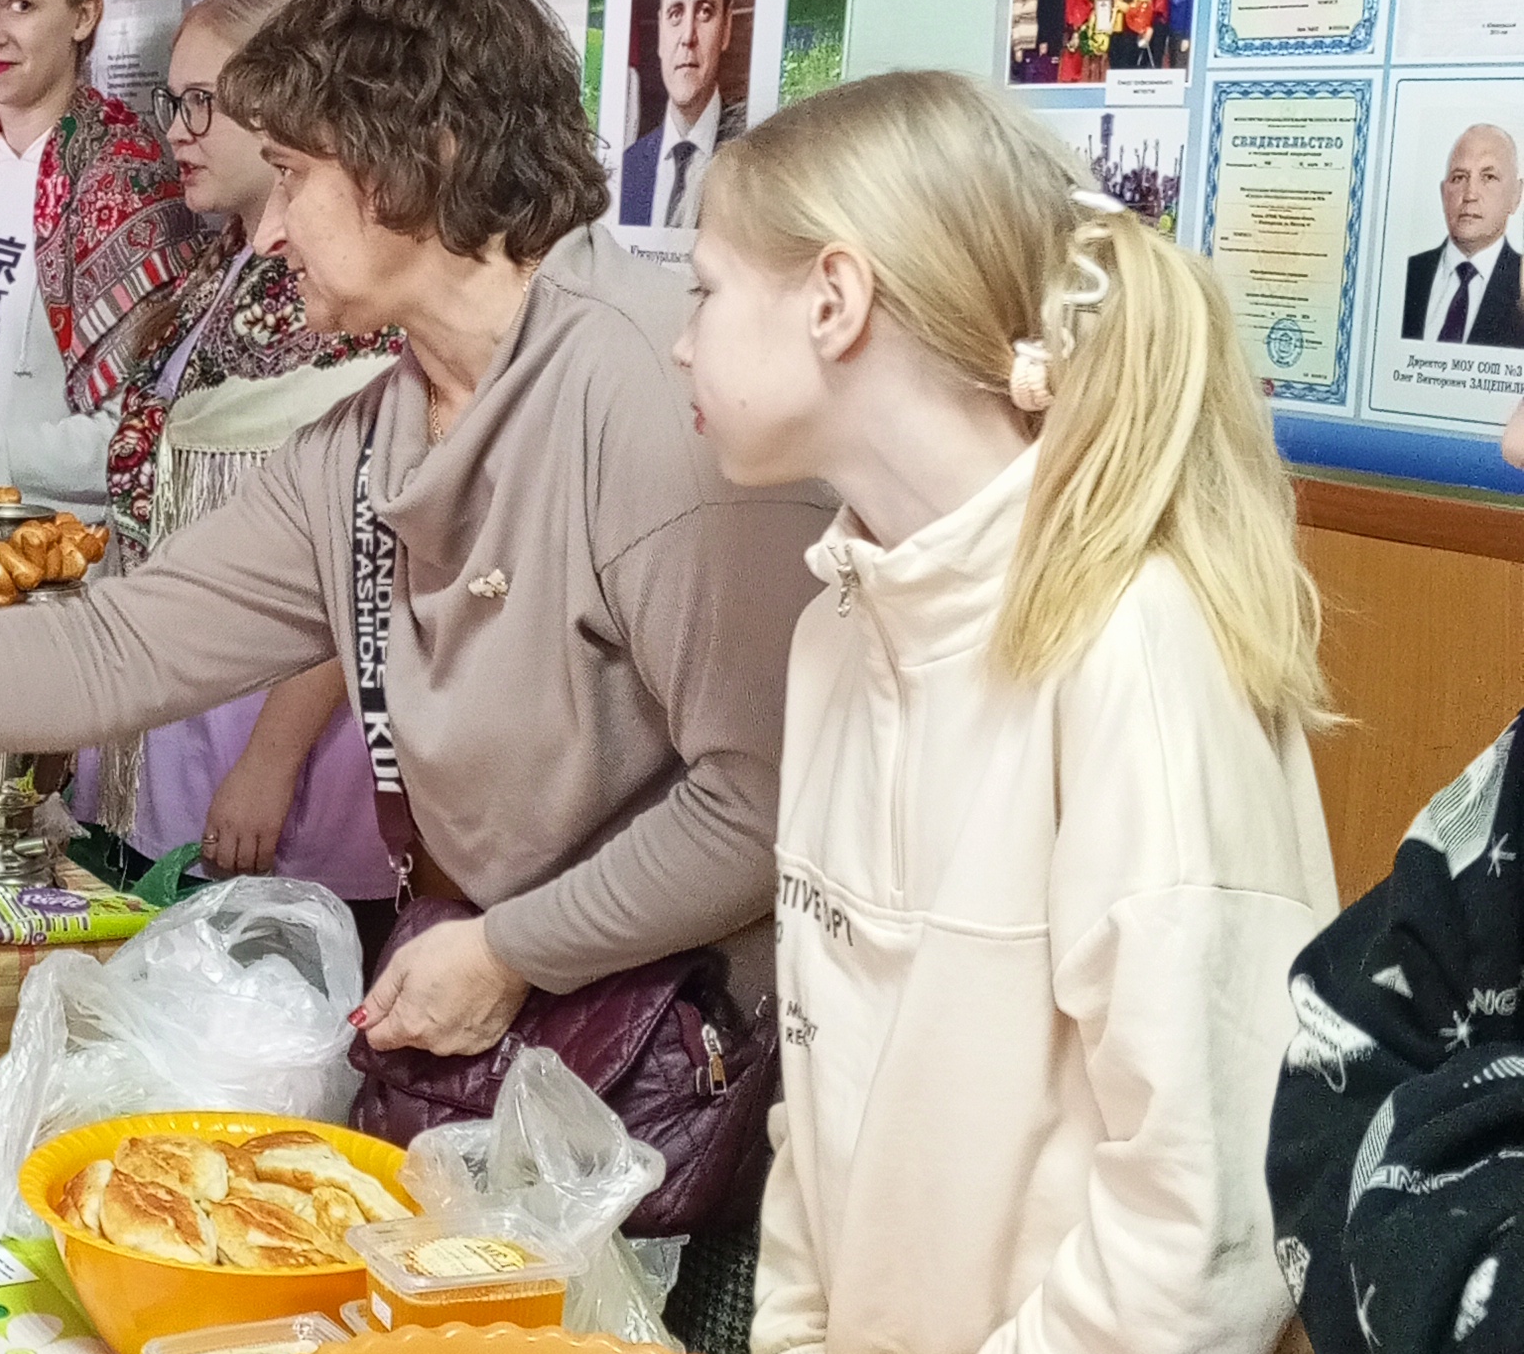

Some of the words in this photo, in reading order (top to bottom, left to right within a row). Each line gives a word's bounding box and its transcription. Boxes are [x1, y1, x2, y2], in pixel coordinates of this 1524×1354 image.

[1231, 135, 1344, 149] СВИДЕТЕЛЬСТВО
[1406, 354, 1447, 373] Директор
[1450, 358, 1475, 372] МОУ
[1477, 361, 1501, 375] СОШ
[1392, 369, 1414, 383] Олег
[1416, 372, 1467, 389] Викторович
